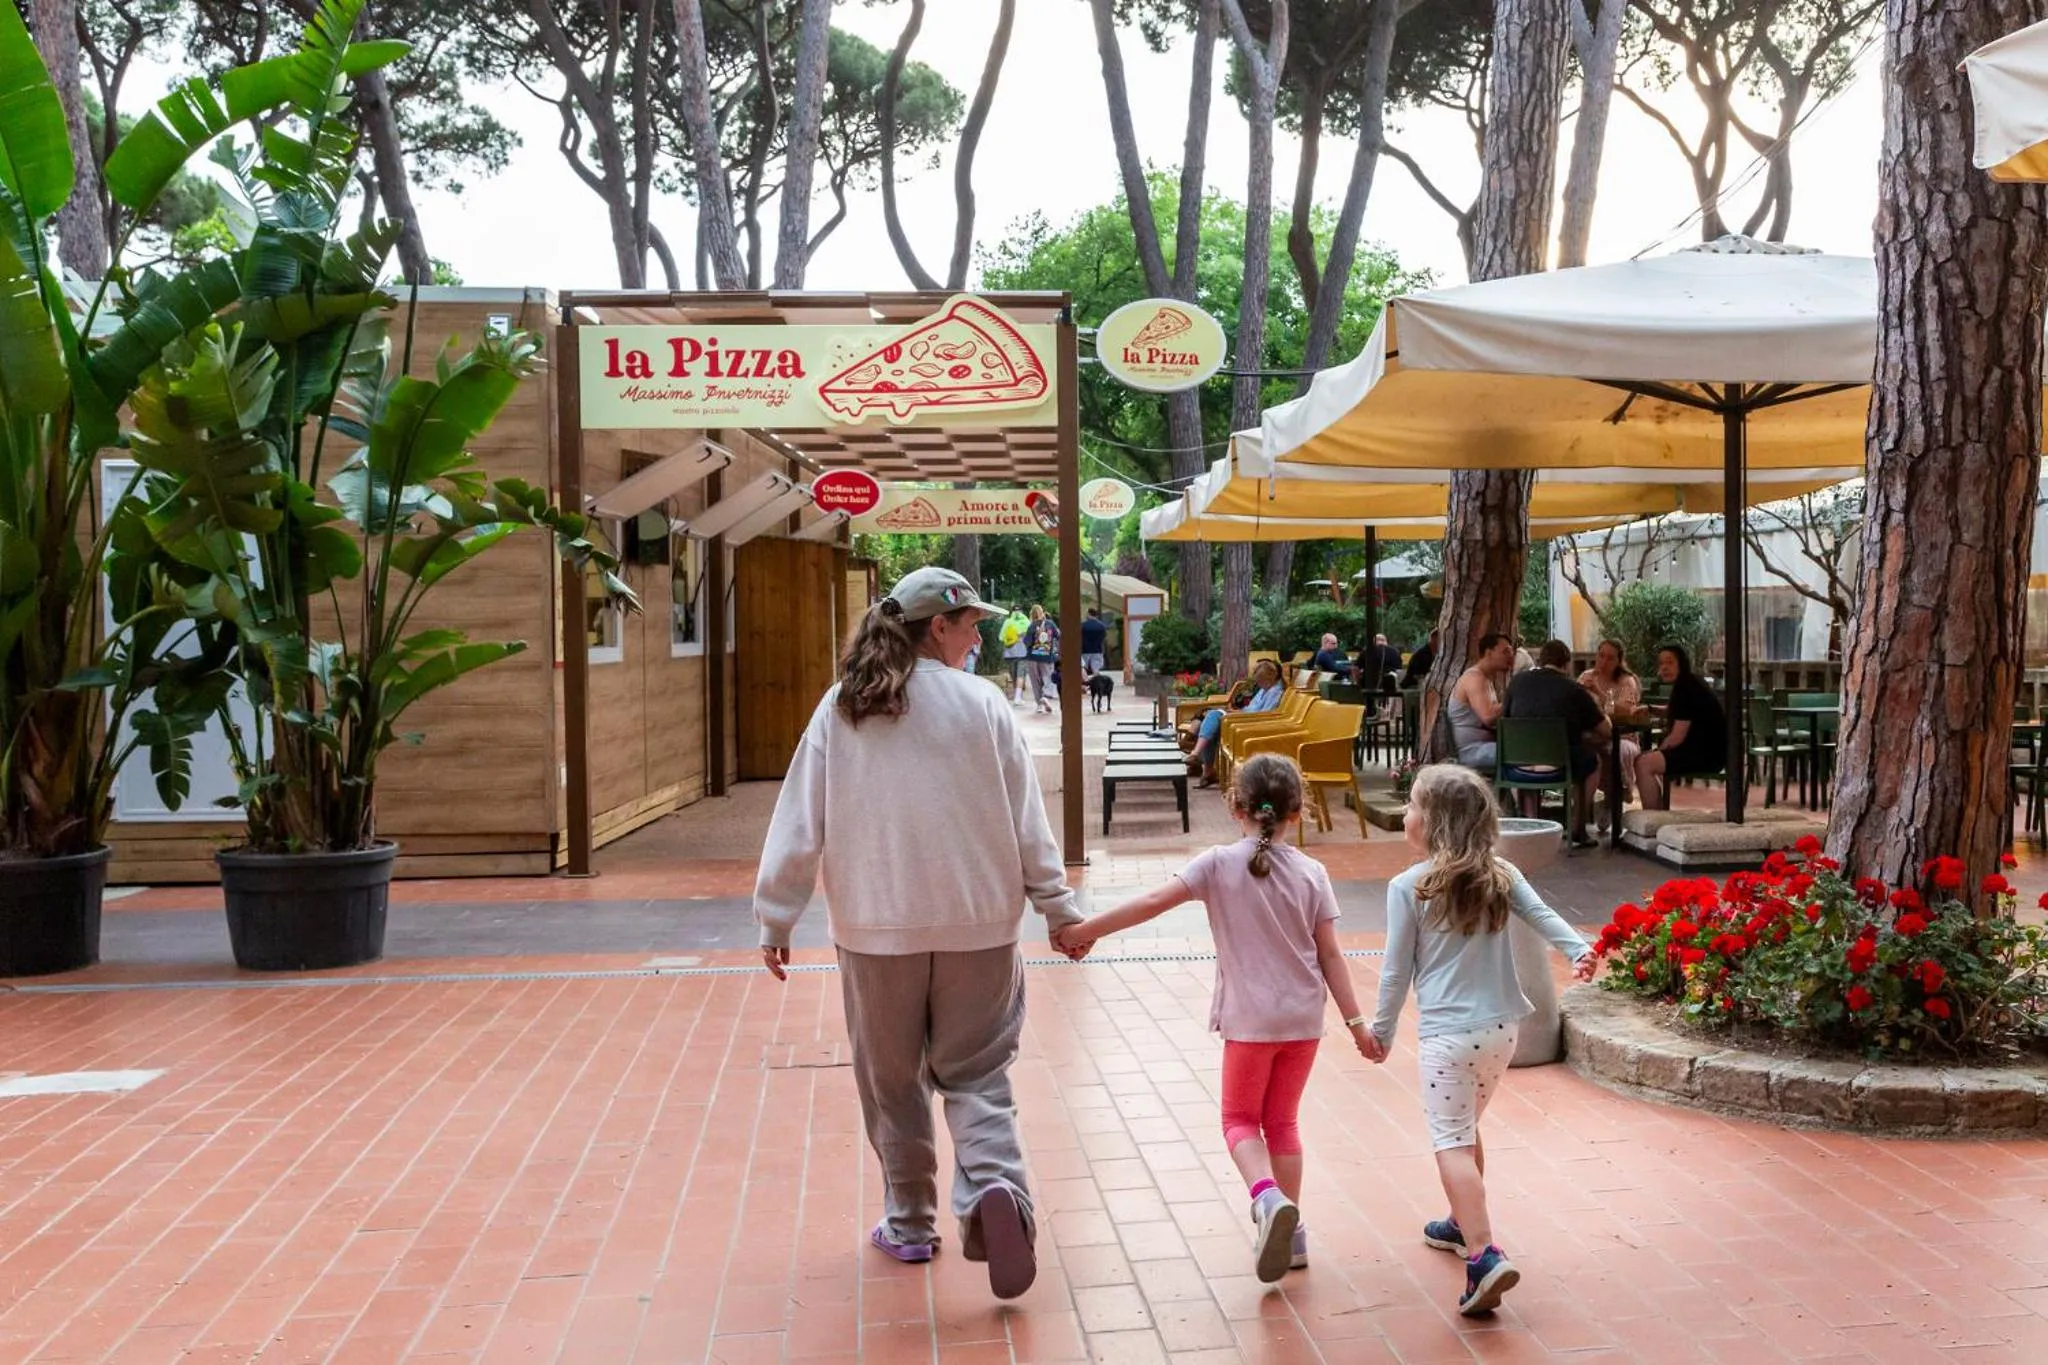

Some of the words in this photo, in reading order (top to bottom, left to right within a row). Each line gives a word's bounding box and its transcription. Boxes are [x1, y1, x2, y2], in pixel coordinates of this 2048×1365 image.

[604, 337, 654, 379] la
[667, 337, 806, 379] Pizza
[1122, 347, 1141, 364] la
[1147, 347, 1200, 365] Pizza
[619, 383, 695, 402] Massimo
[701, 383, 792, 407] Invernizzi
[822, 484, 853, 493] Ordina
[854, 485, 870, 495] qui
[822, 495, 848, 503] Order
[849, 495, 870, 503] here
[959, 500, 1009, 511] Amore
[1012, 503, 1019, 511] a
[947, 513, 991, 526] prima
[994, 514, 1031, 525] fetta
